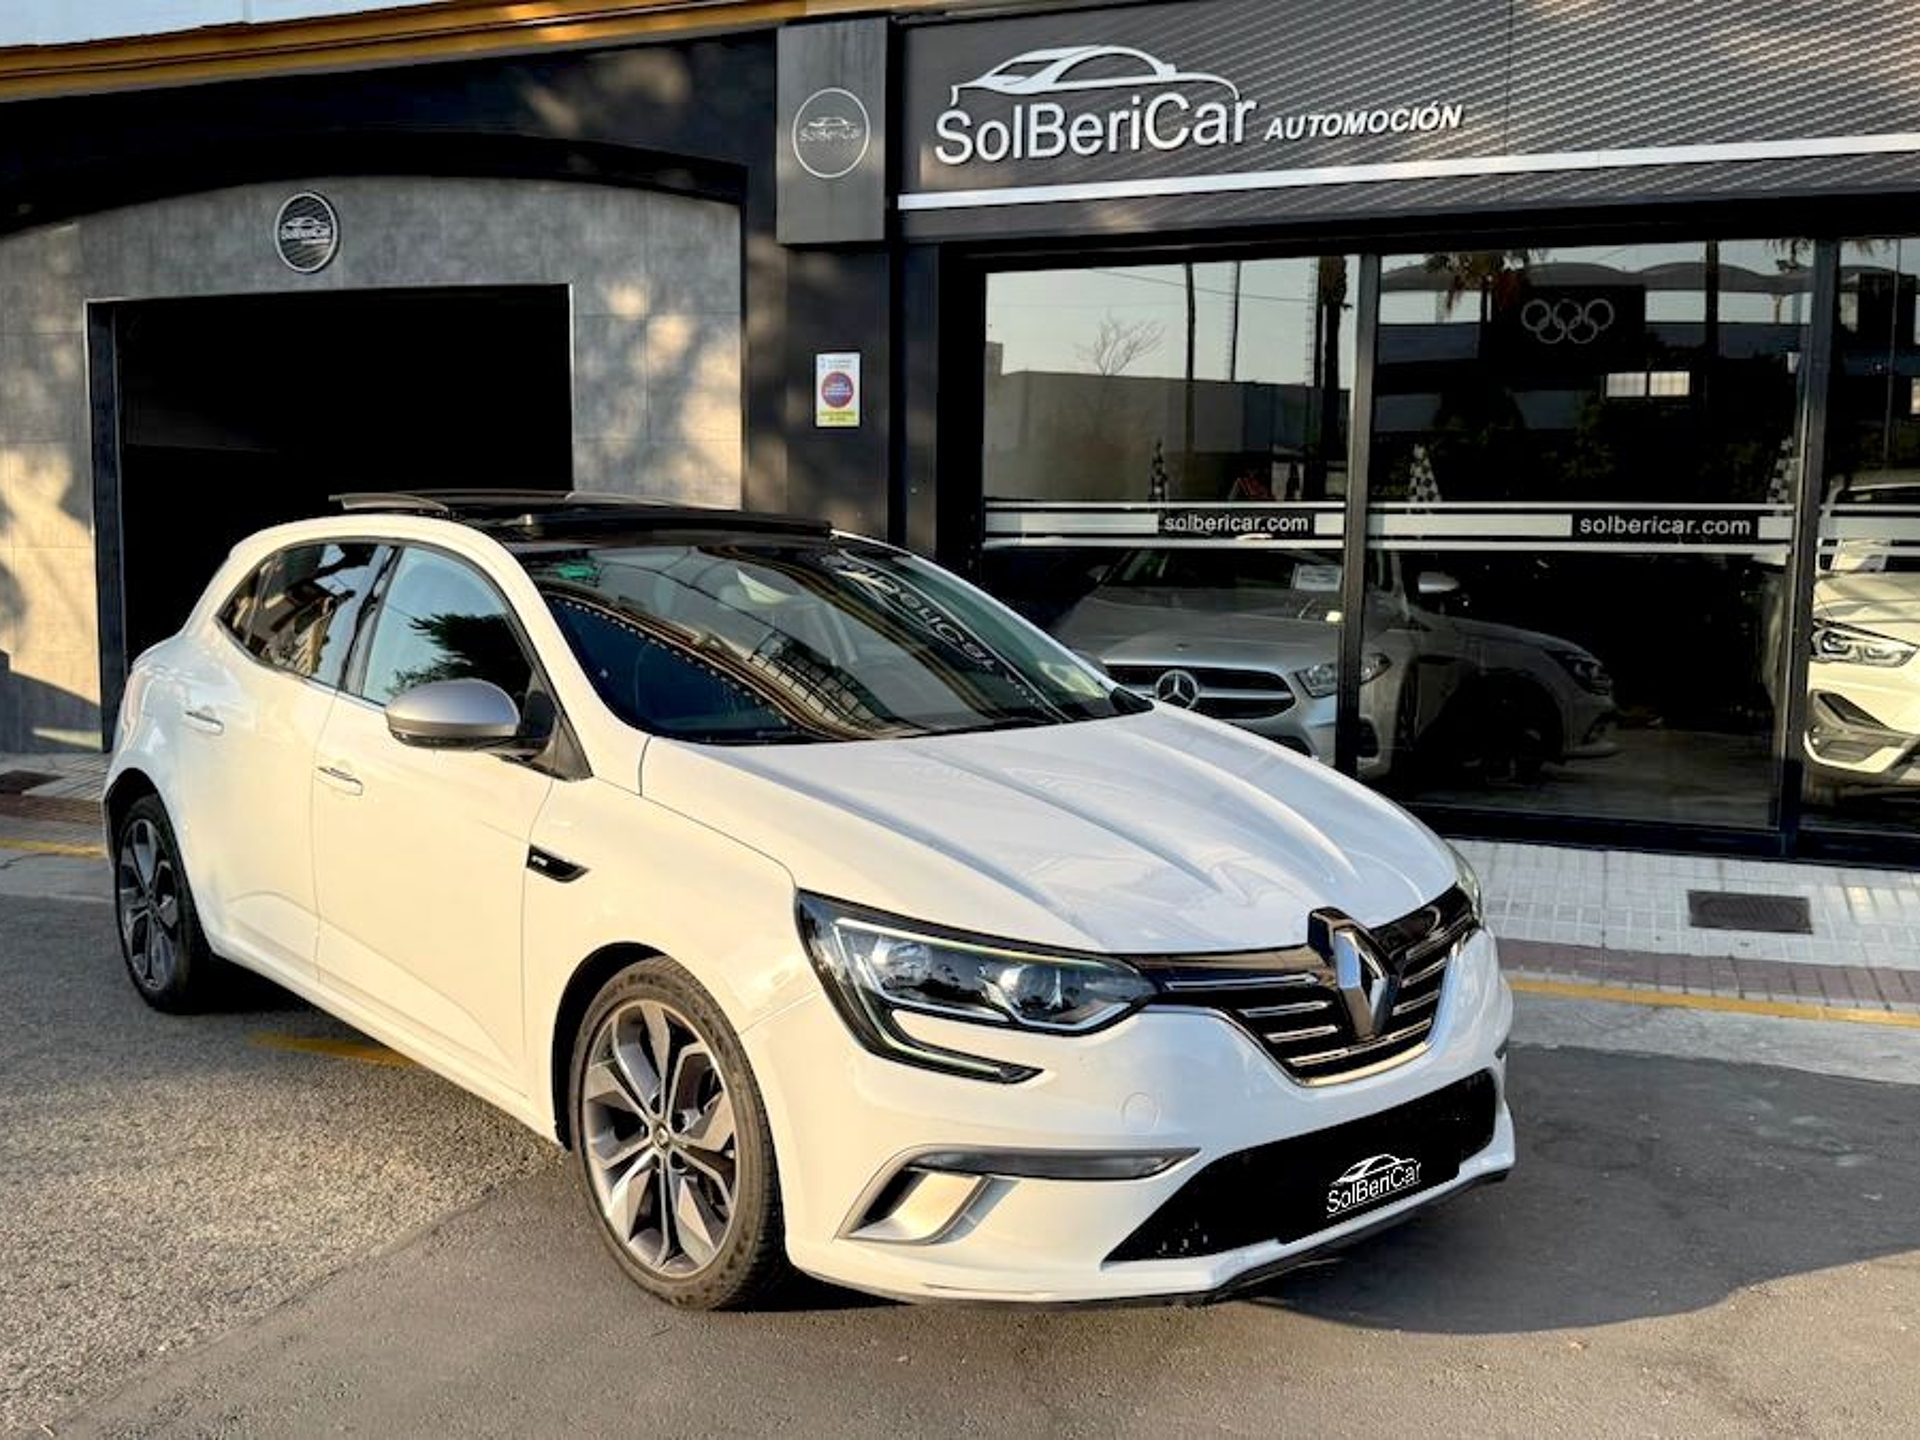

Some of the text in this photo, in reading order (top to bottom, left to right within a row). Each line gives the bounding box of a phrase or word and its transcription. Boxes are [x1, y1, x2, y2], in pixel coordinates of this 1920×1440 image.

[935, 93, 1463, 165] SolBeriCar AUTOMOCIÓN
[1164, 513, 1309, 532] solbericar.com
[1579, 514, 1751, 535] solbericar.com
